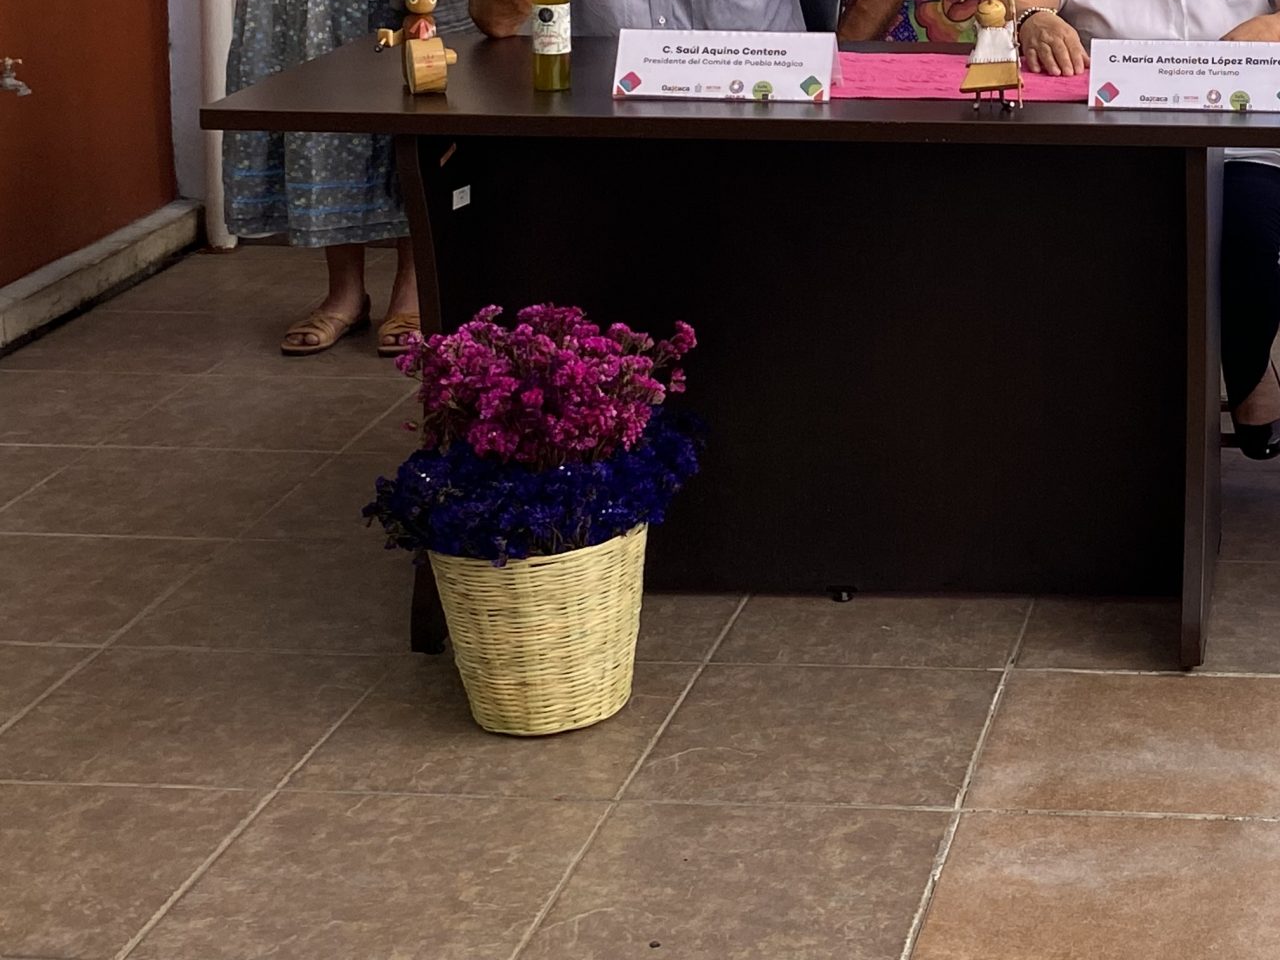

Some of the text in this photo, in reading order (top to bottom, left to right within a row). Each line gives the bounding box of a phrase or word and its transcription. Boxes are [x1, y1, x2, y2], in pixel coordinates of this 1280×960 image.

[662, 45, 787, 57] C. Saúl Aquino Centeno
[643, 57, 687, 65] Presidente
[702, 58, 731, 66] Comité
[744, 59, 772, 67] Pueblo
[1109, 54, 1120, 64] C.
[1122, 54, 1154, 64] María
[1156, 55, 1209, 65] Antonieta
[1211, 55, 1243, 67] López
[1158, 68, 1194, 77] Regidora
[1208, 69, 1240, 77] Turismo
